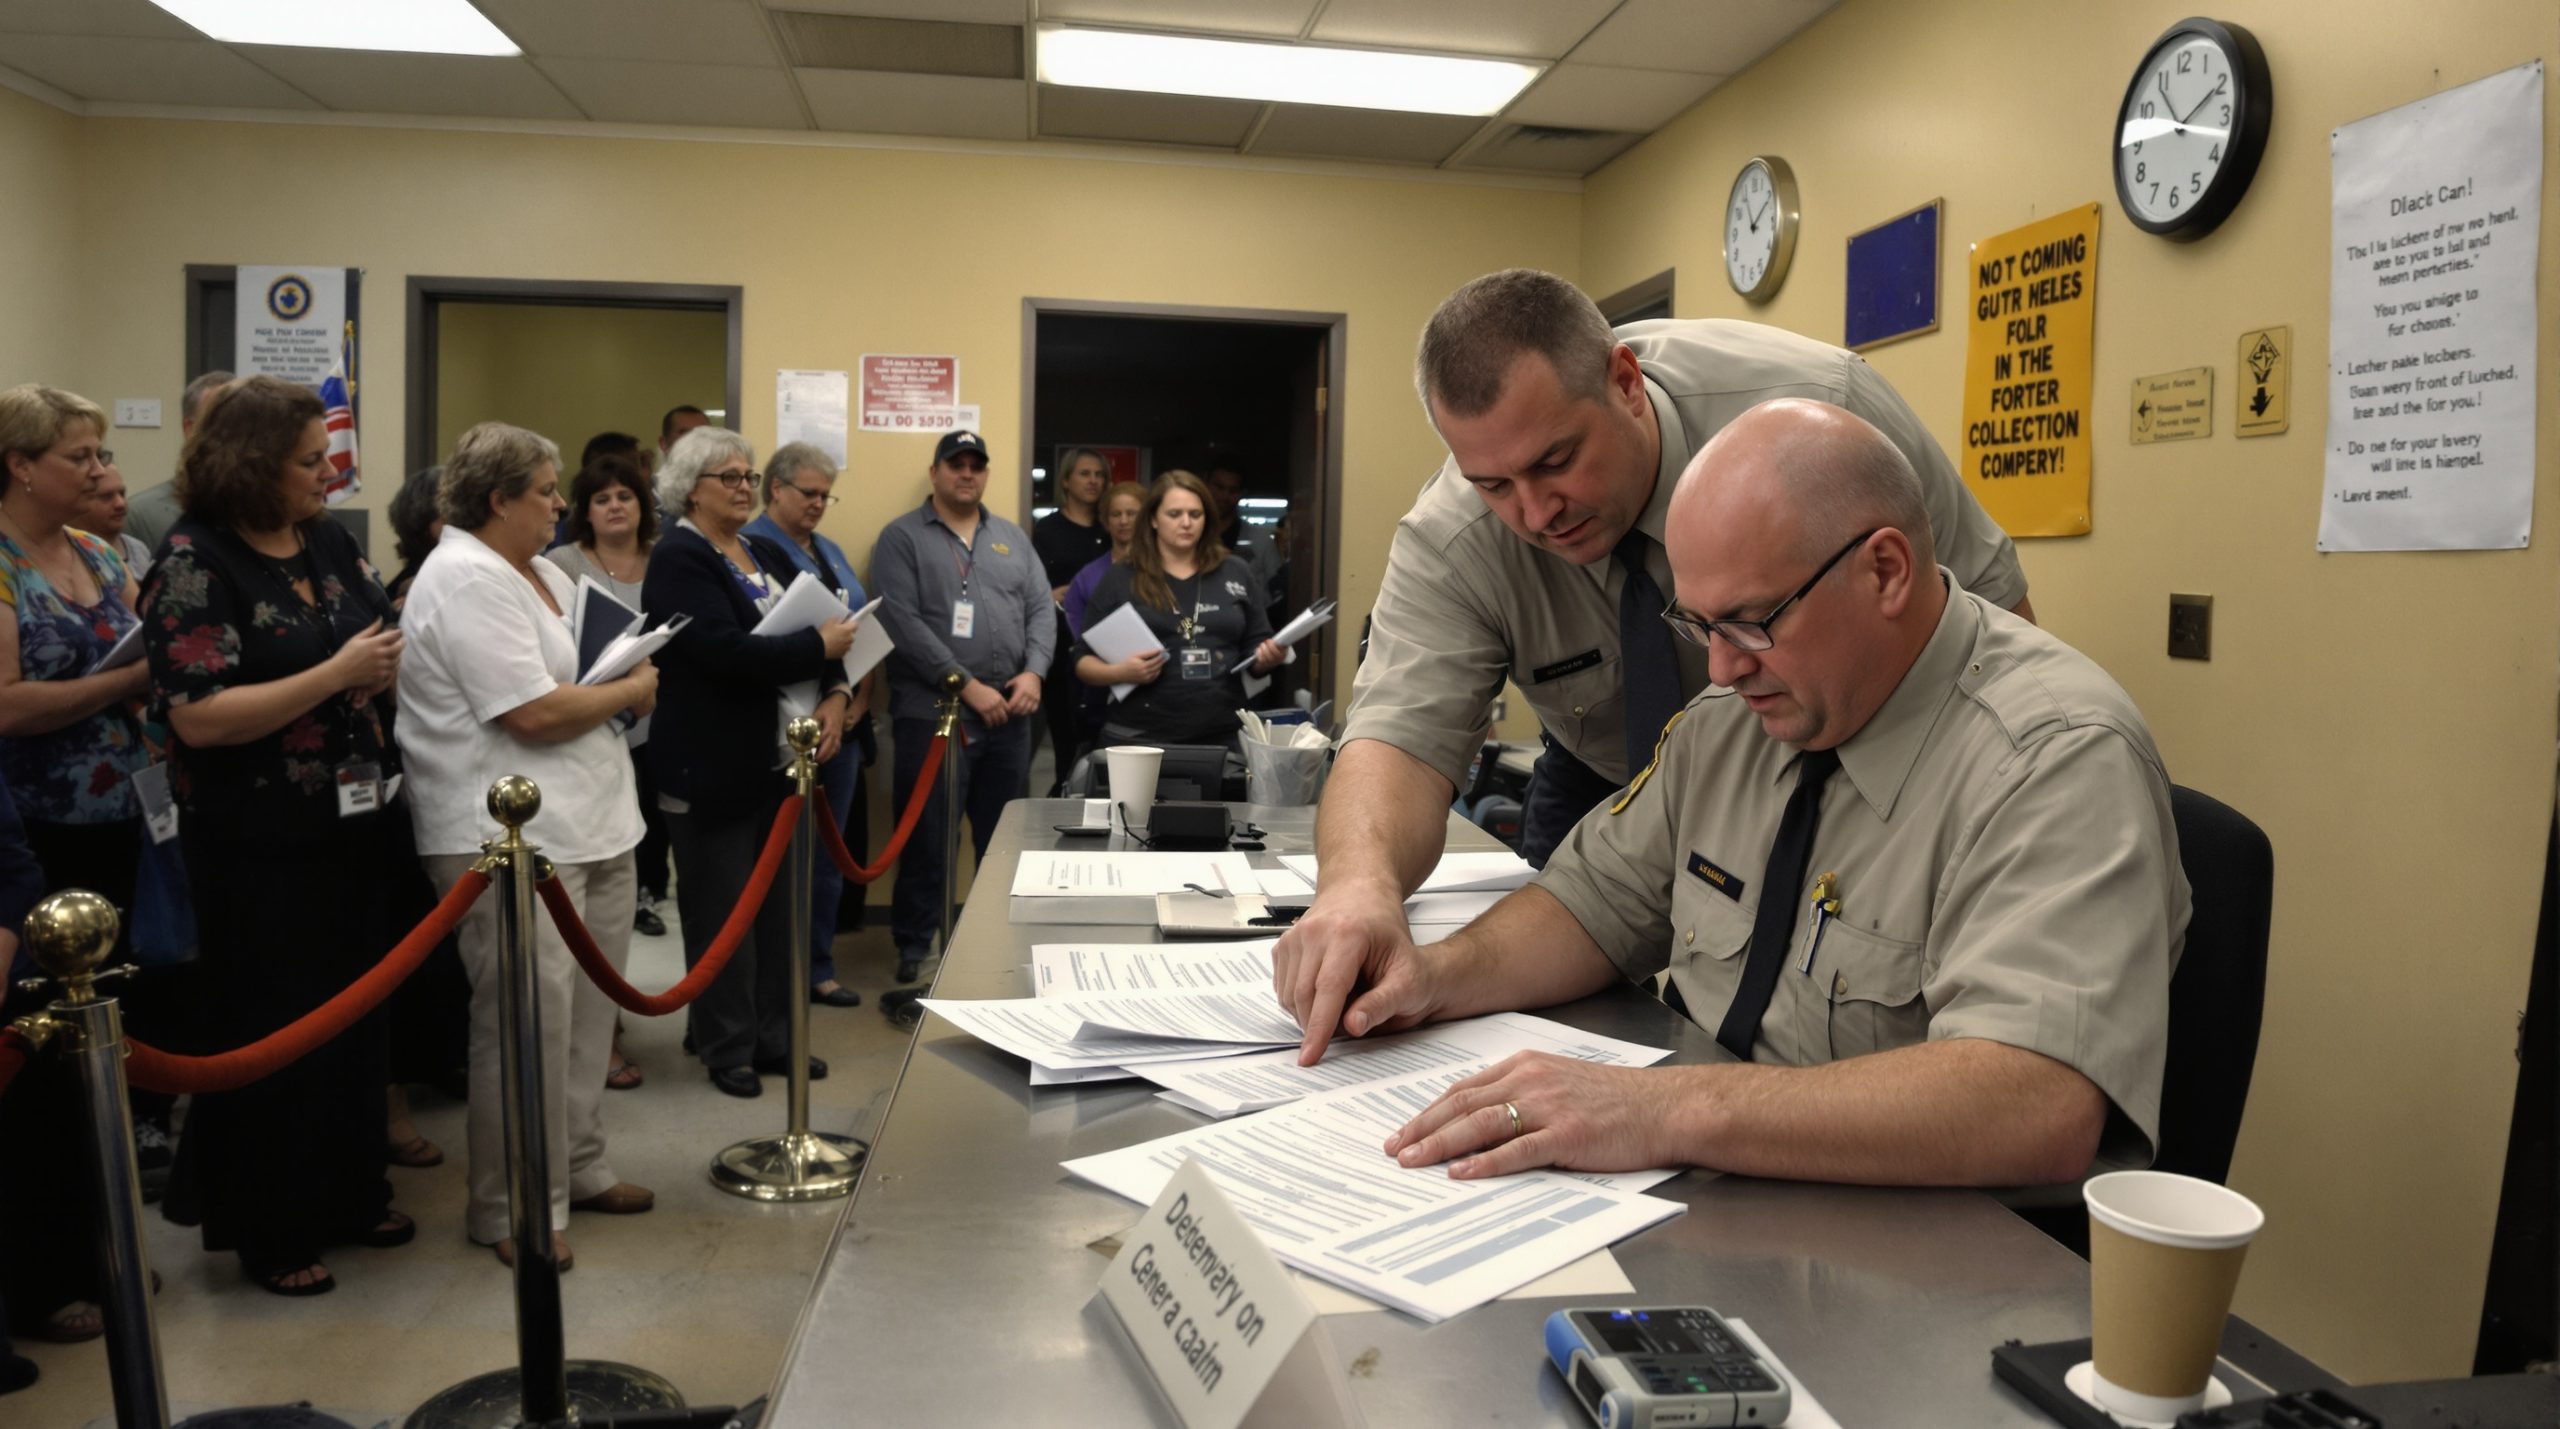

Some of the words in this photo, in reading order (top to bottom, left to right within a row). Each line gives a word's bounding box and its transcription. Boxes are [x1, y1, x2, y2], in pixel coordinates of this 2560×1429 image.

[2177, 51, 2192, 74] 12
[2203, 54, 2208, 73] 1
[2159, 71, 2169, 91] 11
[2214, 73, 2227, 95] 2
[2141, 102, 2154, 119] 10
[2220, 105, 2230, 126] 3
[2133, 140, 2143, 155] 9
[2208, 144, 2219, 163] 4
[2136, 162, 2146, 183] 8
[2191, 172, 2201, 193] 5
[2150, 183, 2159, 204] 7
[2169, 186, 2179, 208] 6
[2433, 224, 2445, 239] of
[2468, 232, 2490, 249] and
[1979, 255, 2015, 288] NOT
[2020, 233, 2086, 278] COMING
[1977, 289, 2022, 321] GUTR
[2374, 304, 2397, 317] You
[2401, 300, 2421, 315] you
[2006, 314, 2047, 346] FOLR
[1995, 353, 2011, 381] IN
[2018, 345, 2053, 375] THE
[2415, 376, 2447, 391] front
[2451, 371, 2464, 386] of
[1991, 379, 2059, 413] FORTER
[2378, 403, 2399, 417] and
[1969, 410, 2079, 448] COLLECTION
[2348, 441, 2364, 455] Do
[2391, 438, 2407, 450] for
[2411, 438, 2438, 452] your
[1981, 446, 2065, 480] COMPERY!
[1236, 1302, 1265, 1348] on
